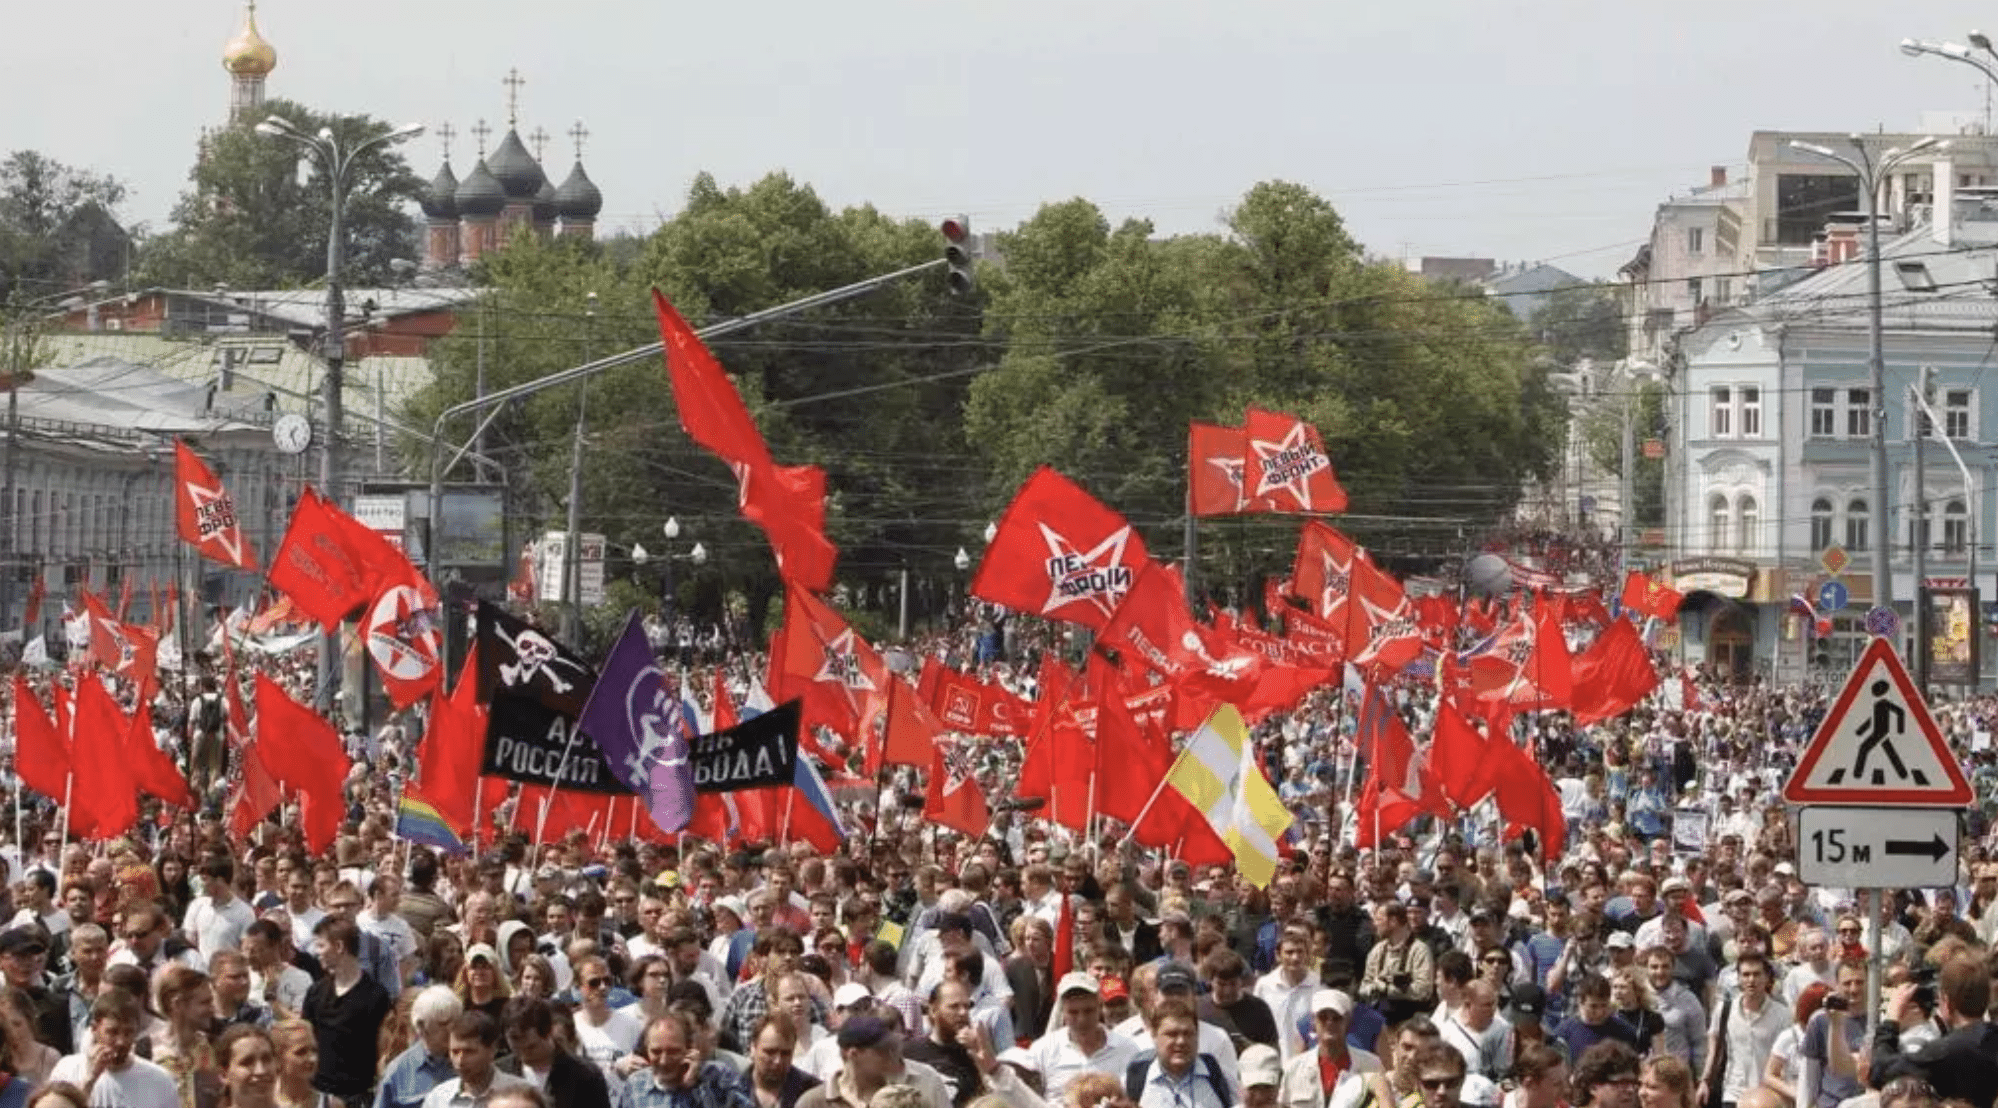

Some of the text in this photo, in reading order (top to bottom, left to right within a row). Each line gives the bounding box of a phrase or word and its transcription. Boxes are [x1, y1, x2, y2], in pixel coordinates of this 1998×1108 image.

[1267, 456, 1319, 485] ФРОНТ
[495, 736, 599, 783] РОССИЯ
[1812, 828, 1845, 863] 15
